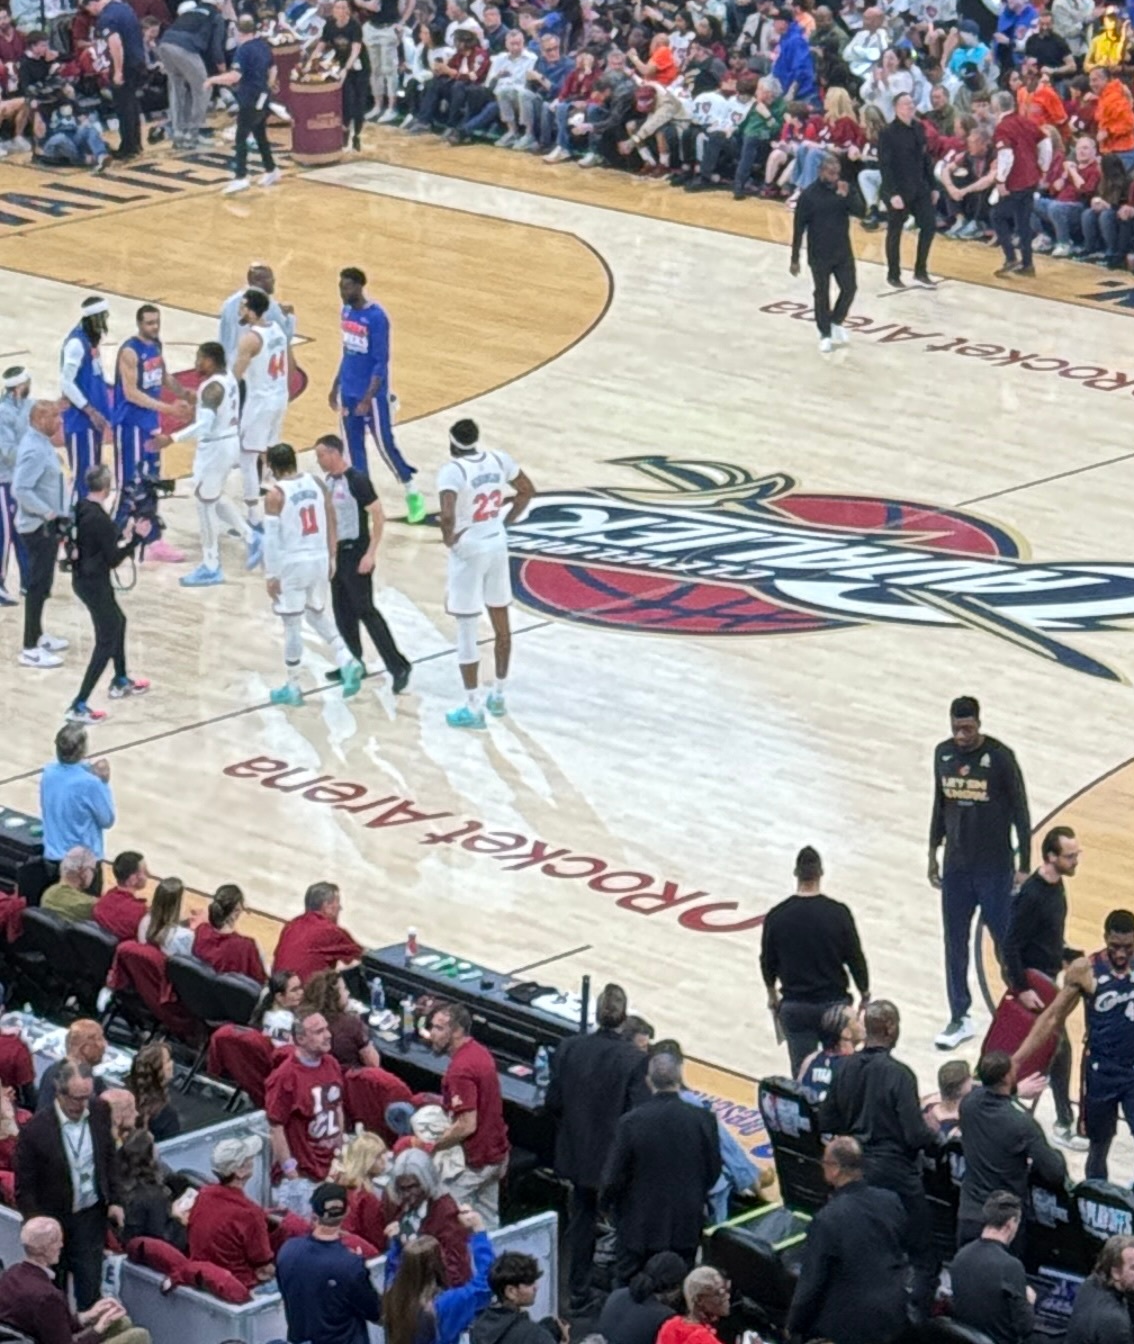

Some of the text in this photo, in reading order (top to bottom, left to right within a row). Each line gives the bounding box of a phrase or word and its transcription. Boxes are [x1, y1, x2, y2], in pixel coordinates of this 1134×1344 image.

[267, 351, 288, 381] 44
[926, 337, 1134, 391] Rocket
[472, 491, 502, 524] 23
[222, 755, 709, 916] Rocket Arena
